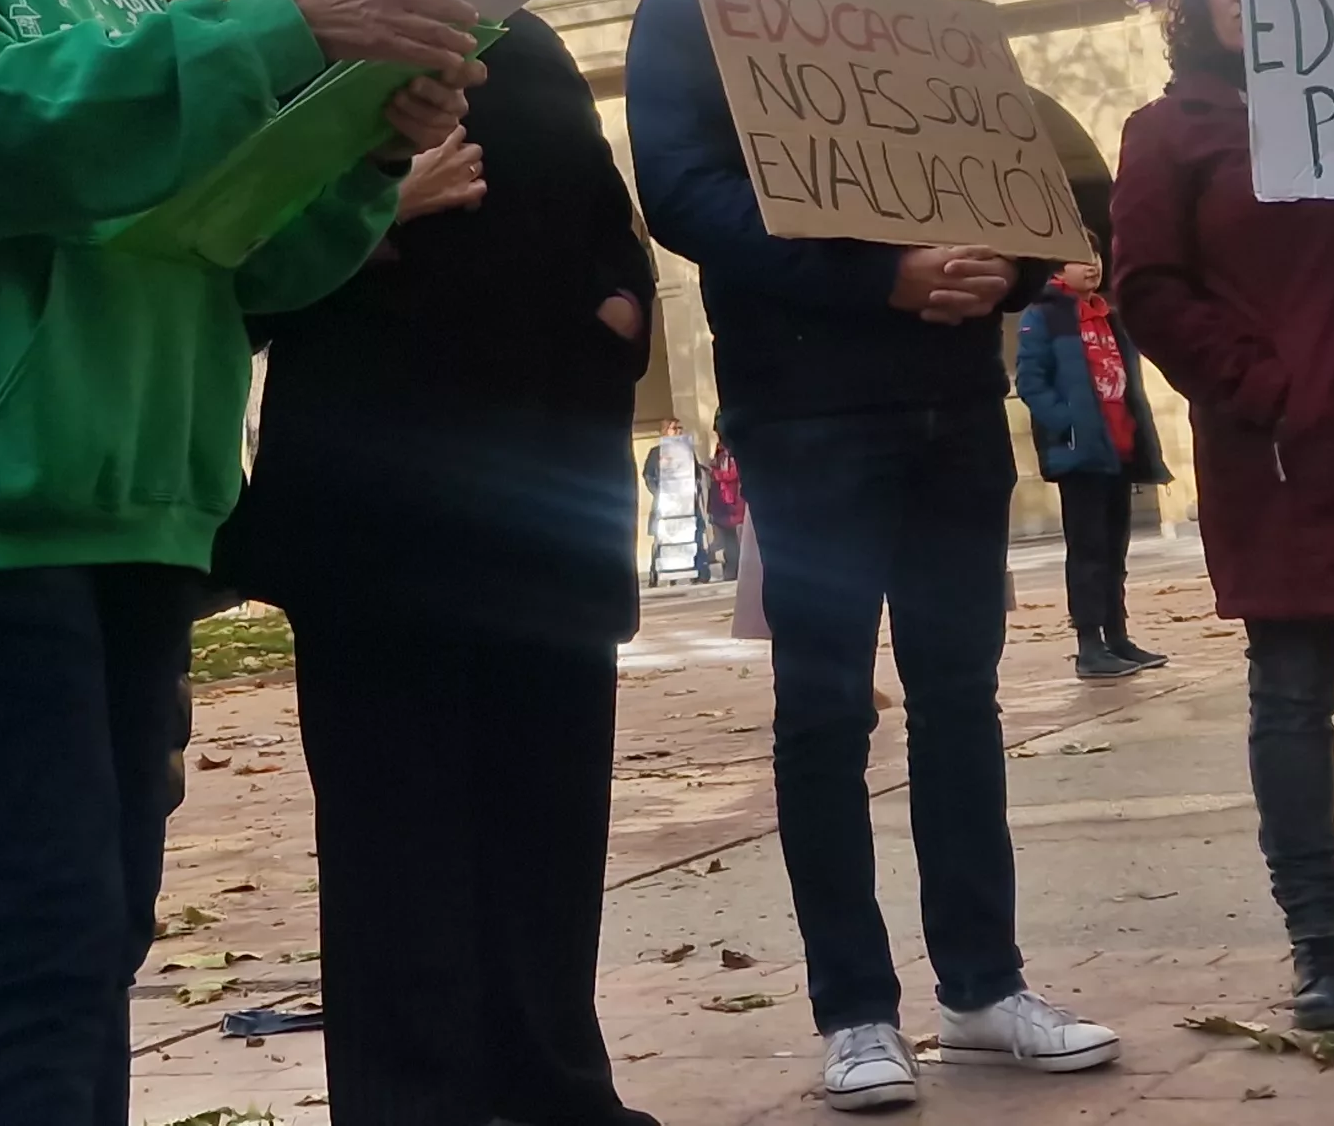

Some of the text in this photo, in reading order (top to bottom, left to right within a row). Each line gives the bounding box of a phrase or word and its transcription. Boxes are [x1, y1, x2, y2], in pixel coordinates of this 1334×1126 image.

[747, 52, 1038, 143] NO ES SOLO
[747, 131, 1087, 239] EVALUACIÓN
